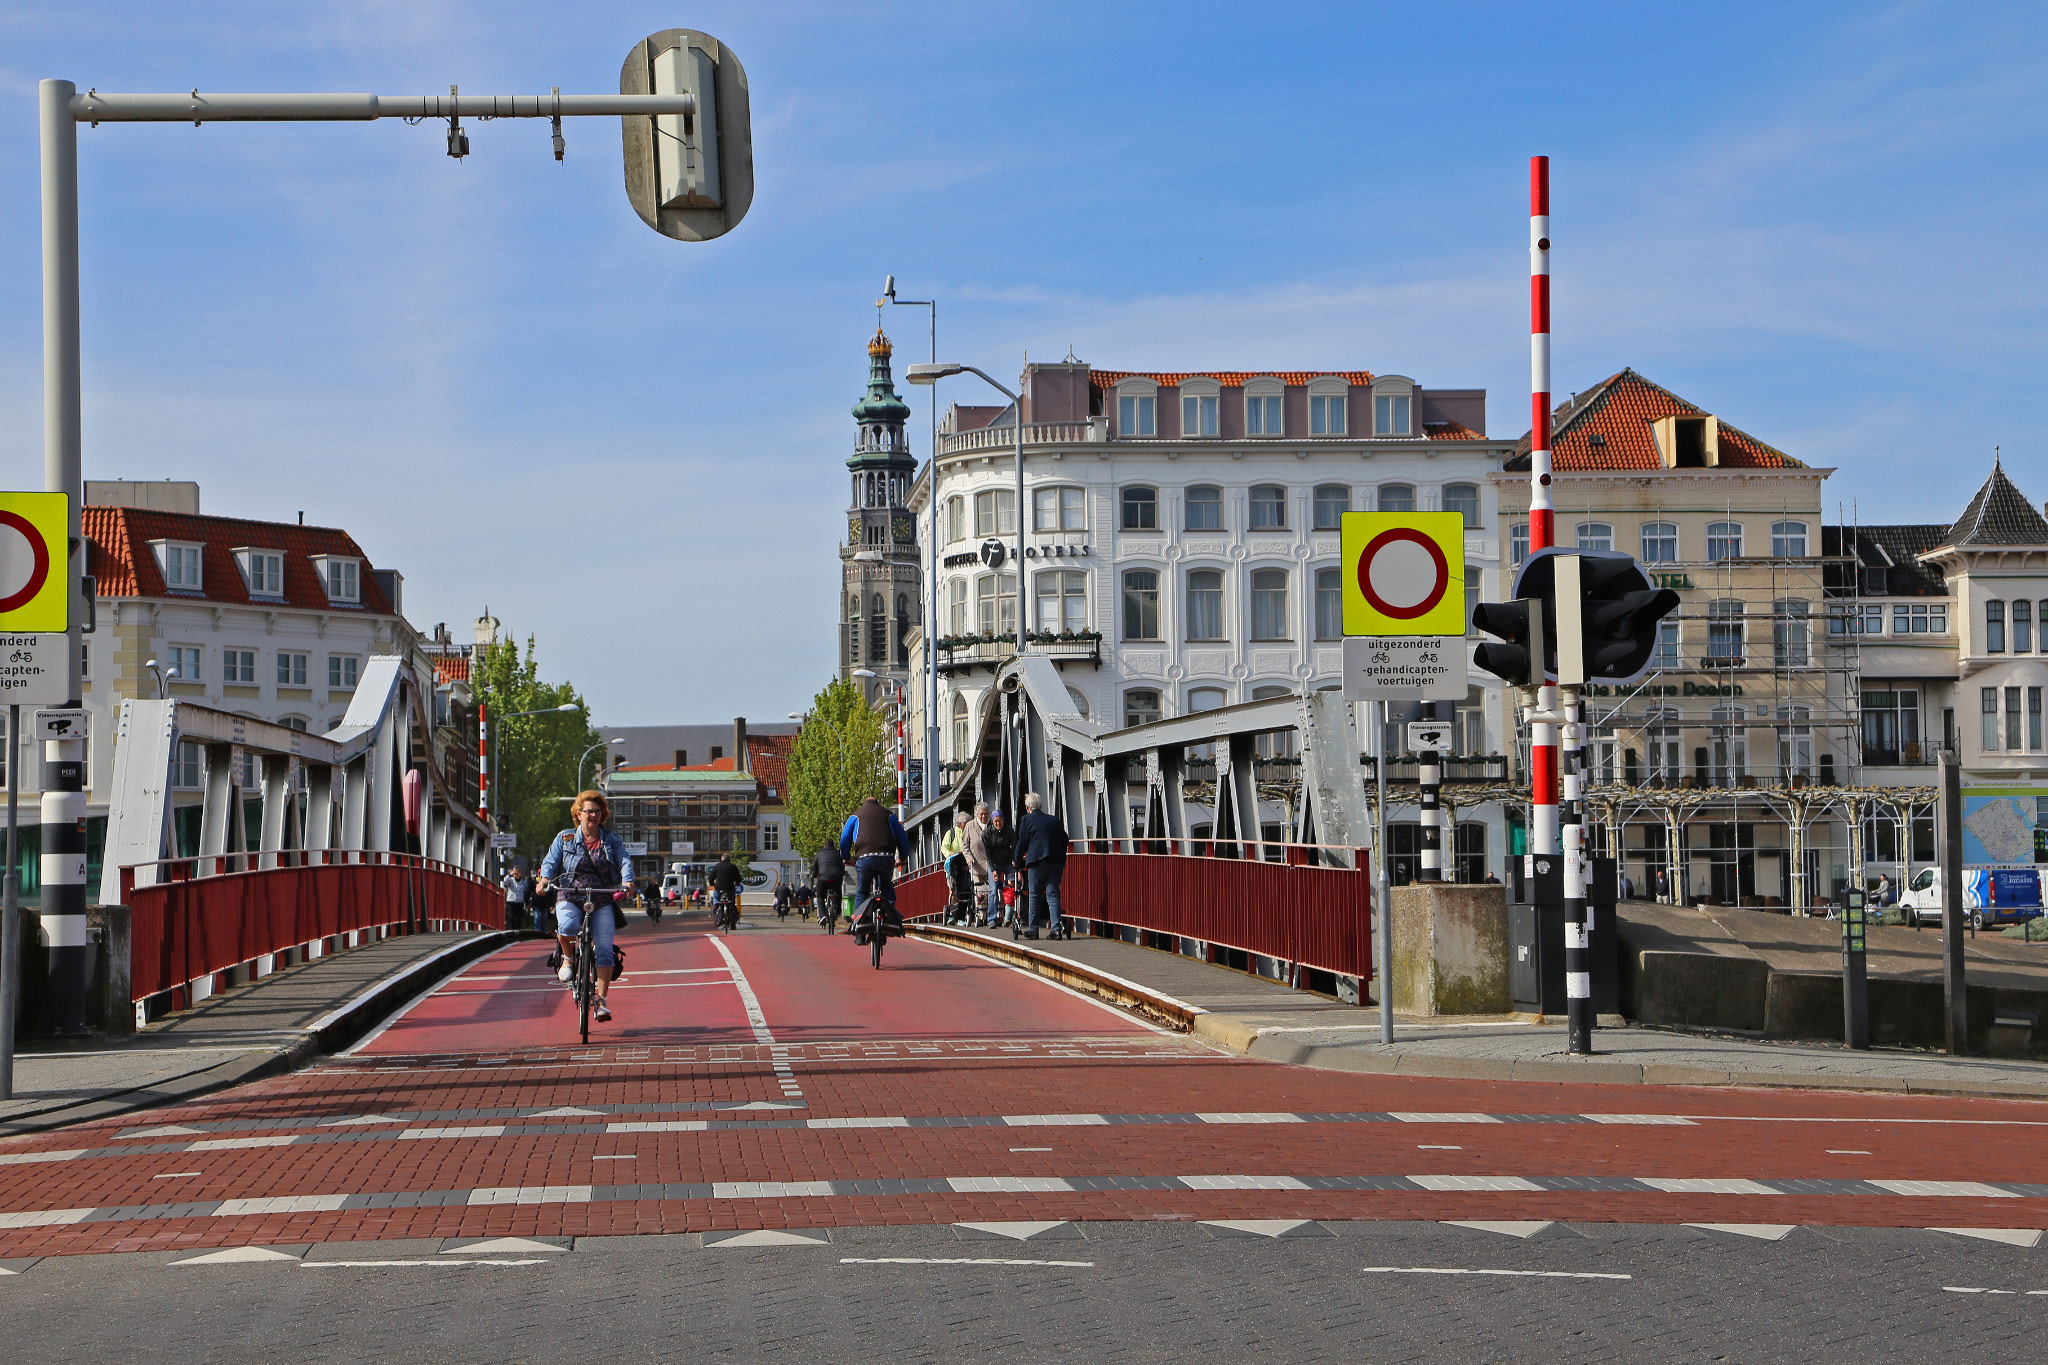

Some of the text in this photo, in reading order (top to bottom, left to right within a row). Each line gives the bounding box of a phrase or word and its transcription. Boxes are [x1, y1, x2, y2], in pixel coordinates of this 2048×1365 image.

[1010, 545, 1089, 559] HOTELS
[1368, 640, 1441, 651] uitgezonderd
[1362, 665, 1449, 676] -gehandicapten-
[1377, 676, 1435, 687] voertuigen
[1586, 681, 1743, 697] De Nieuwe Doelen
